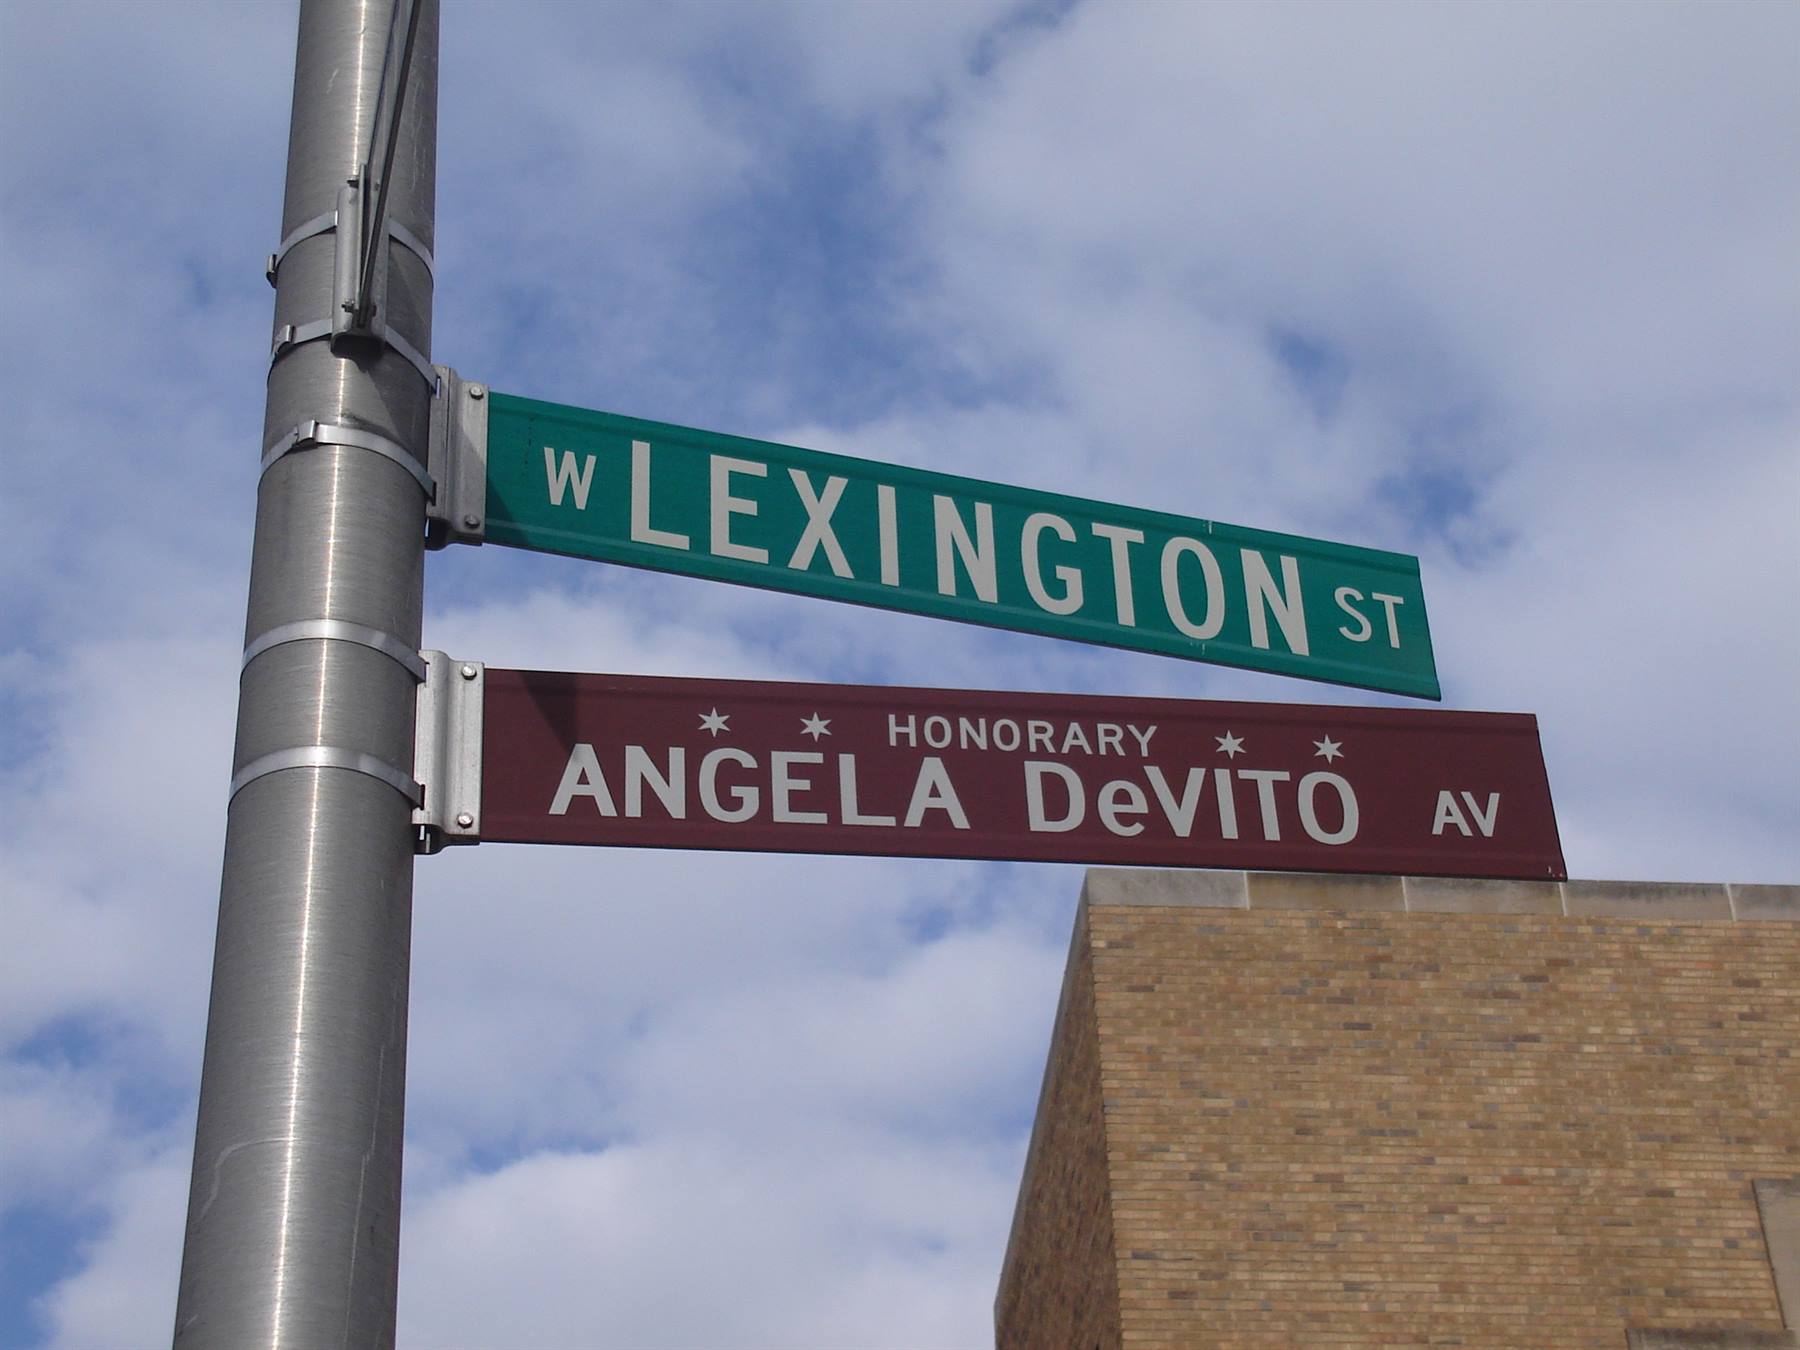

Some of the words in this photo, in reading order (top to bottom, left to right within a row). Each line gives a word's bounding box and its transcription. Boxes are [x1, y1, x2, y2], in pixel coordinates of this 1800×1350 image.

[543, 447, 597, 510] W
[630, 440, 1310, 657] LEXINGTON
[1333, 586, 1405, 650] ST
[887, 713, 1158, 758] HONORARY
[548, 742, 971, 829] ANGELA
[1024, 760, 1360, 845] DeVITO
[1431, 790, 1501, 837] AV
